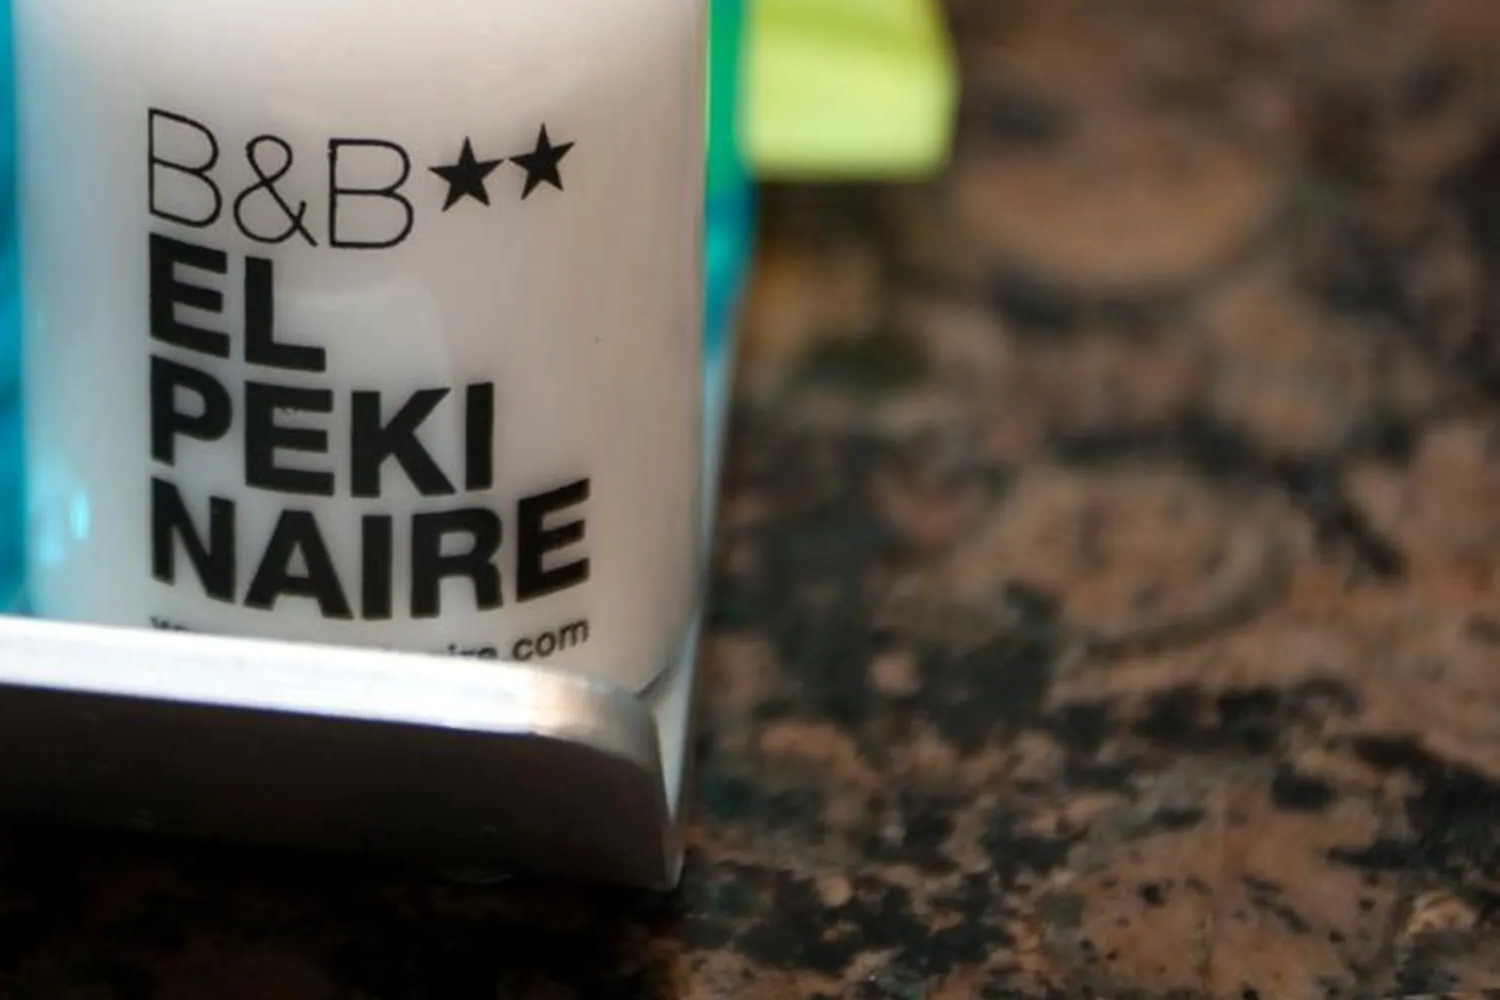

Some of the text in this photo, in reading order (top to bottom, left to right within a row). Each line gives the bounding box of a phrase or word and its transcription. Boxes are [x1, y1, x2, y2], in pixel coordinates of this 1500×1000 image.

[148, 107, 415, 250] B&B
[149, 231, 326, 373] EL
[150, 353, 494, 499] PEKI
[150, 476, 591, 620] NAIRE
